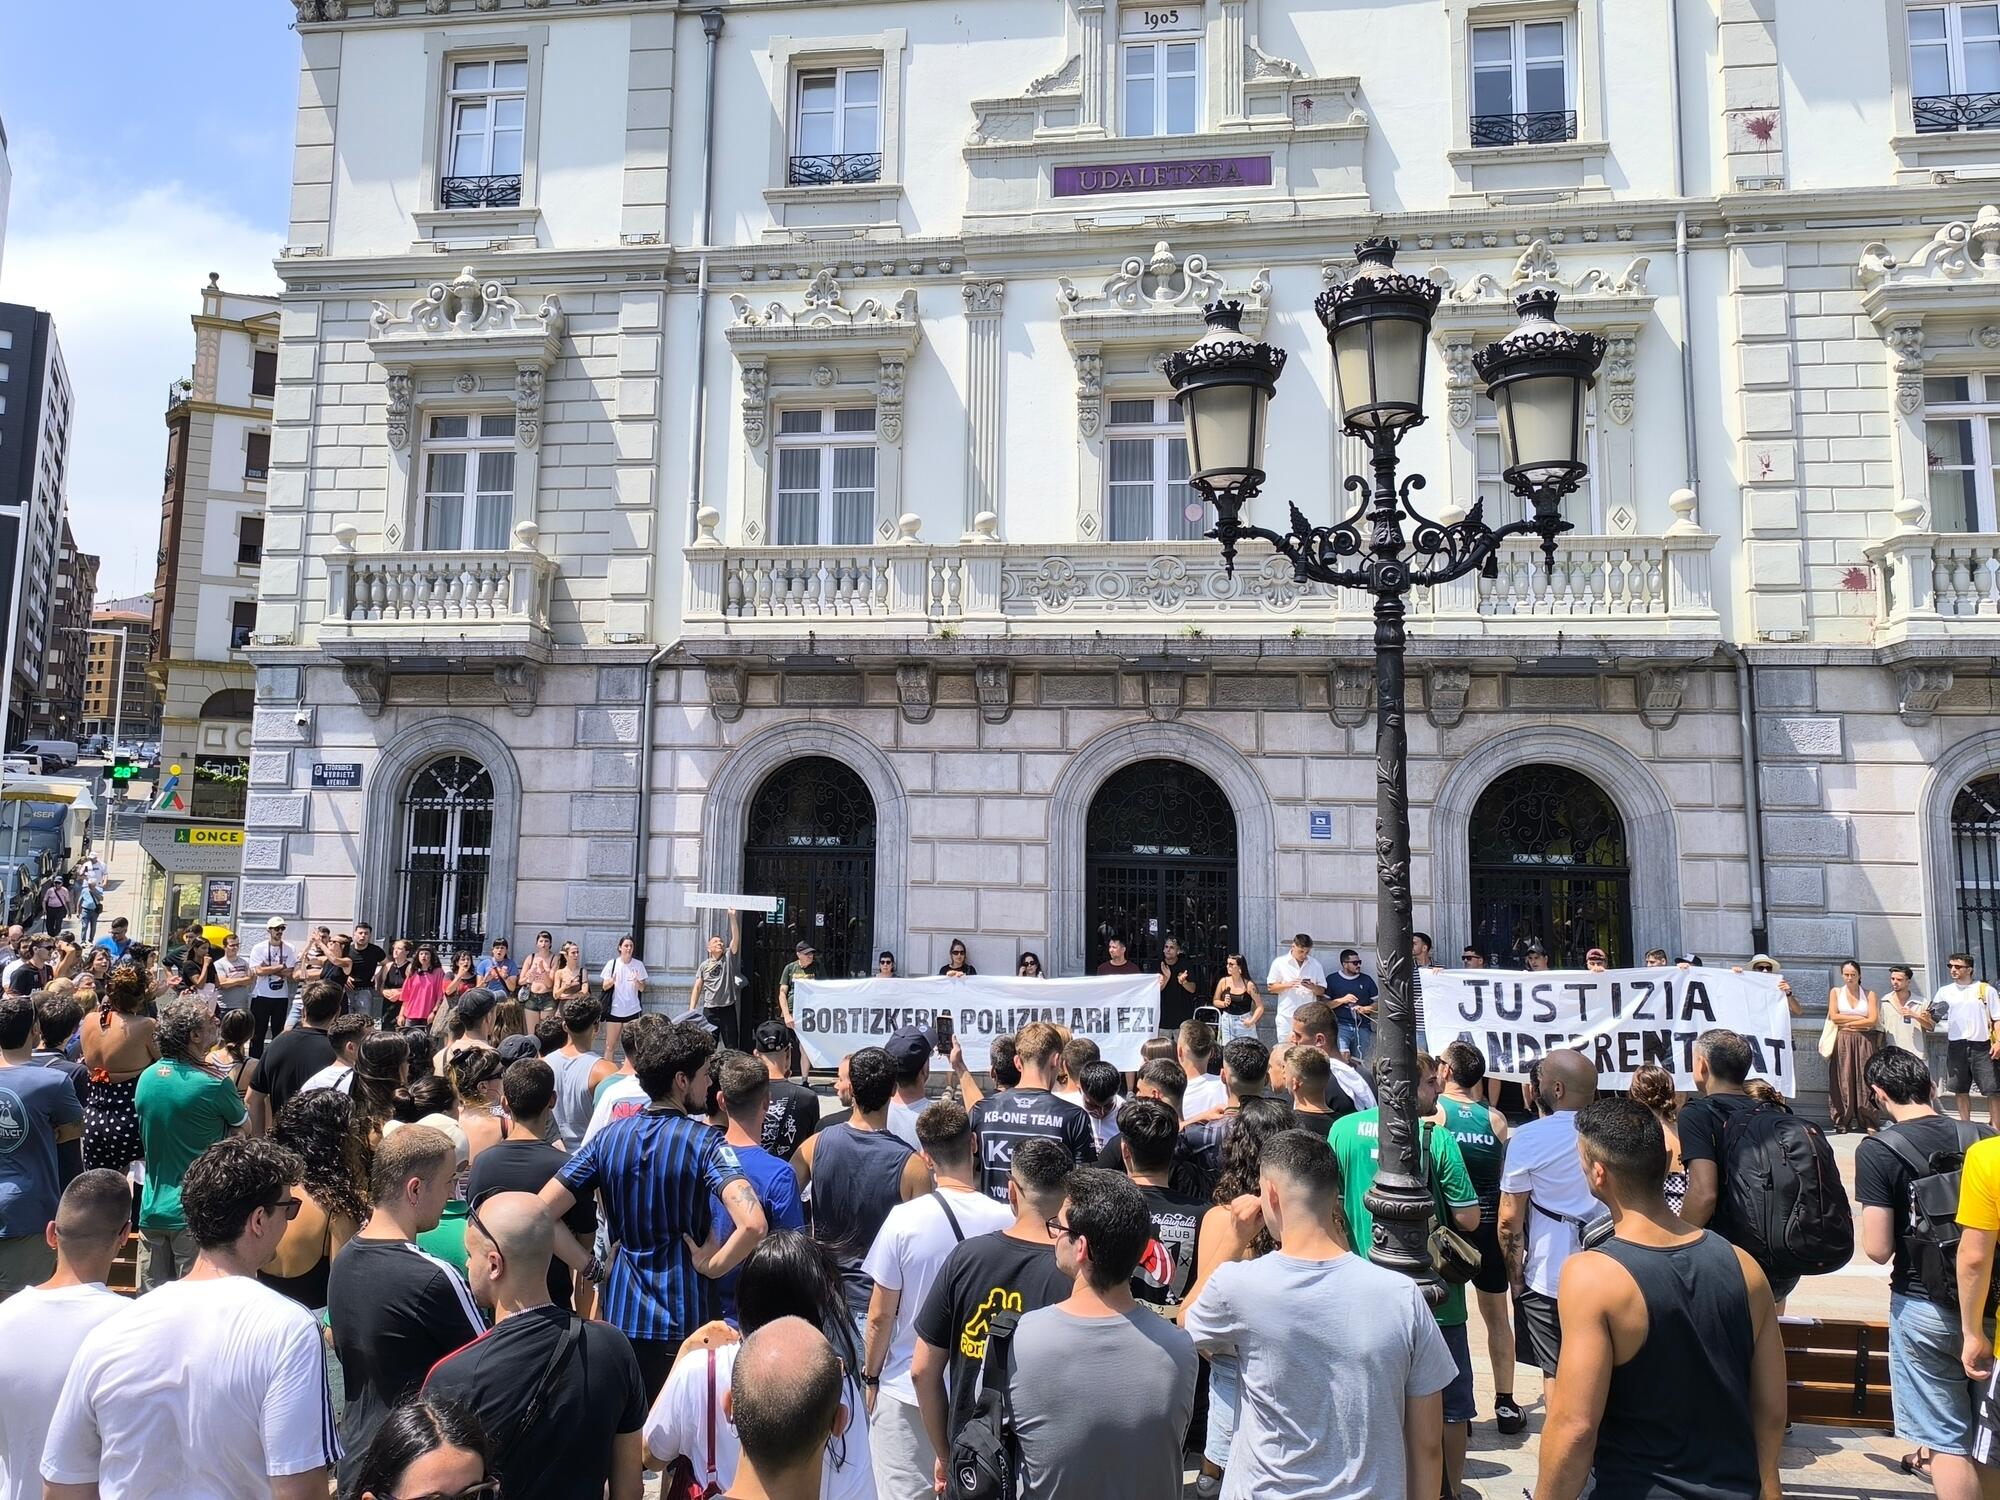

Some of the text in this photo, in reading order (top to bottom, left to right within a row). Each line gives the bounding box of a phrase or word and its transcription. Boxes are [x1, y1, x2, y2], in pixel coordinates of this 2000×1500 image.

[1144, 10, 1179, 30] 1905
[1079, 162, 1243, 191] UDALETXEA
[195, 832, 238, 842] ONCE
[1458, 979, 1716, 1023] JUSTIZIA
[802, 1007, 952, 1034] BORTIZKERI
[1117, 1007, 1154, 1032] EZ!
[984, 1111, 1063, 1128] KB-ONE TEAM
